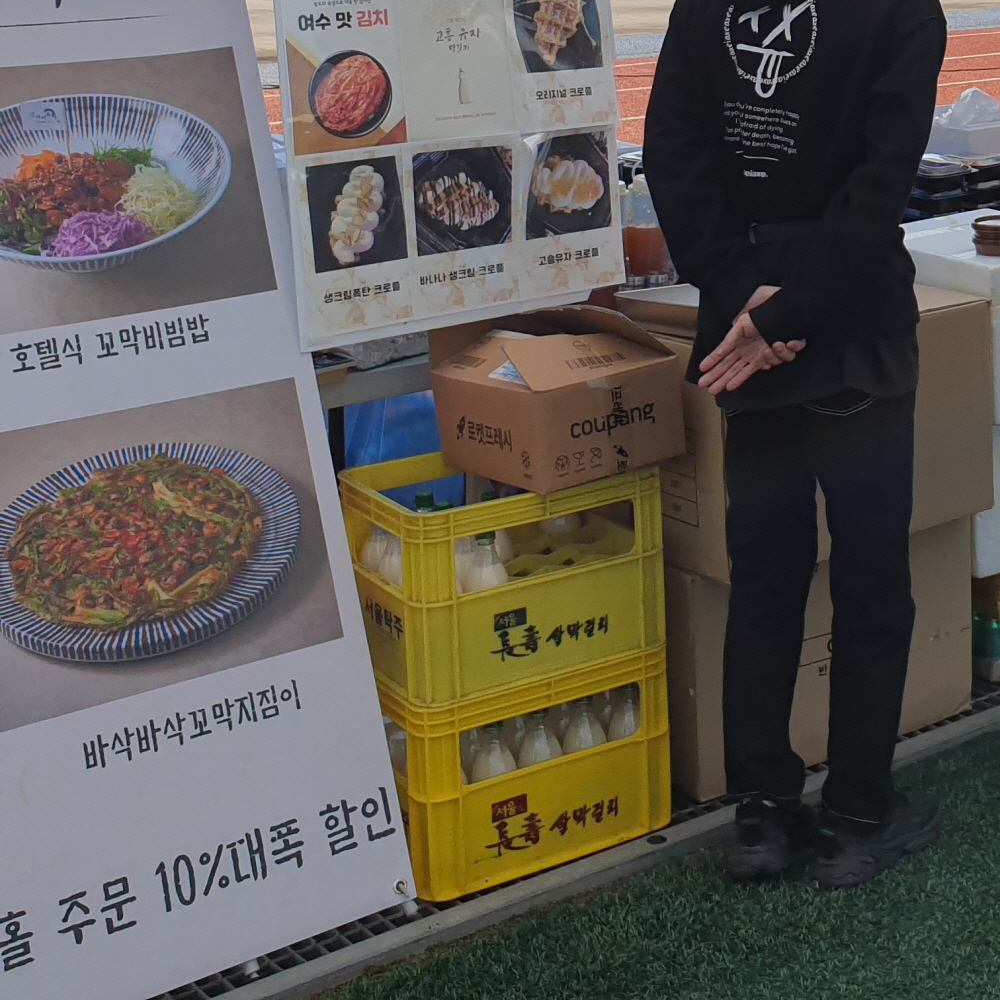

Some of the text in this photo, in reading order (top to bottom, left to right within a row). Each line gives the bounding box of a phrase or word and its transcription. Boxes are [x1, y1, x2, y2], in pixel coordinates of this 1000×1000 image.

[298, 8, 389, 31] 여수 맛 김치
[435, 27, 482, 43] 고흥 유자
[535, 86, 593, 101] 오리지널 크로플
[574, 247, 599, 260] 크로플
[419, 262, 504, 286] 바나나 생크림 크로플
[323, 280, 401, 304] 생크림폭탄 크로플
[9, 313, 210, 373] 호텔식 꼬막비빔밥
[570, 402, 656, 439] coupang
[467, 420, 513, 452] 로켓프레시
[82, 679, 302, 769] 바삭바삭꼬막지짐이
[495, 800, 517, 818] 서울
[58, 876, 137, 945] 주문
[155, 818, 304, 913] 10%대폭
[319, 786, 396, 857] 할인
